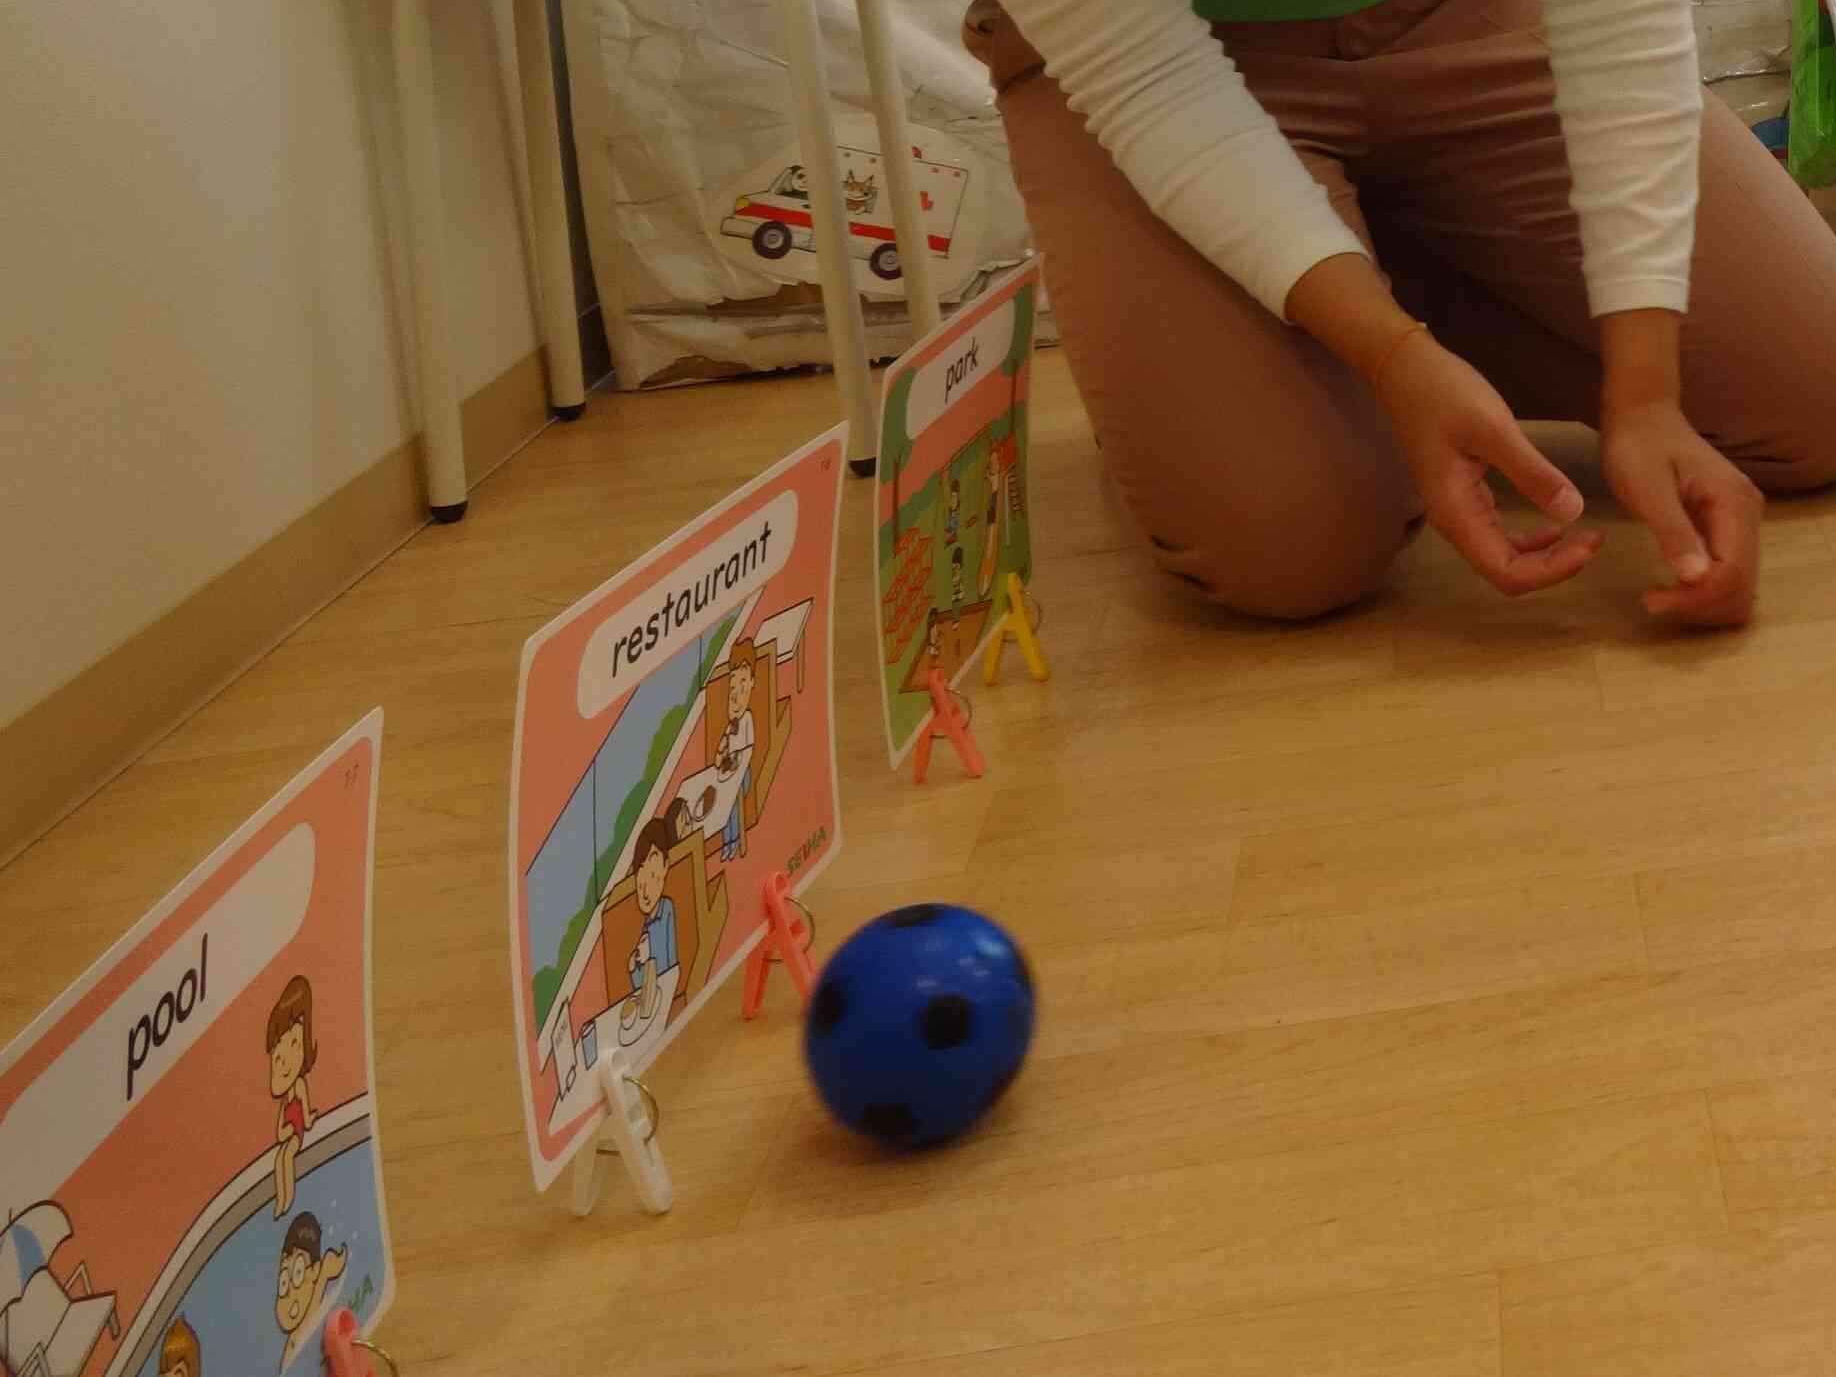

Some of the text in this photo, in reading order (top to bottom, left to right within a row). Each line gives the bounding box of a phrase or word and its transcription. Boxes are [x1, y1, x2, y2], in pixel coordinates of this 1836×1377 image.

[944, 337, 979, 404] park
[612, 521, 771, 678] restaurant
[126, 932, 208, 1101] pool
